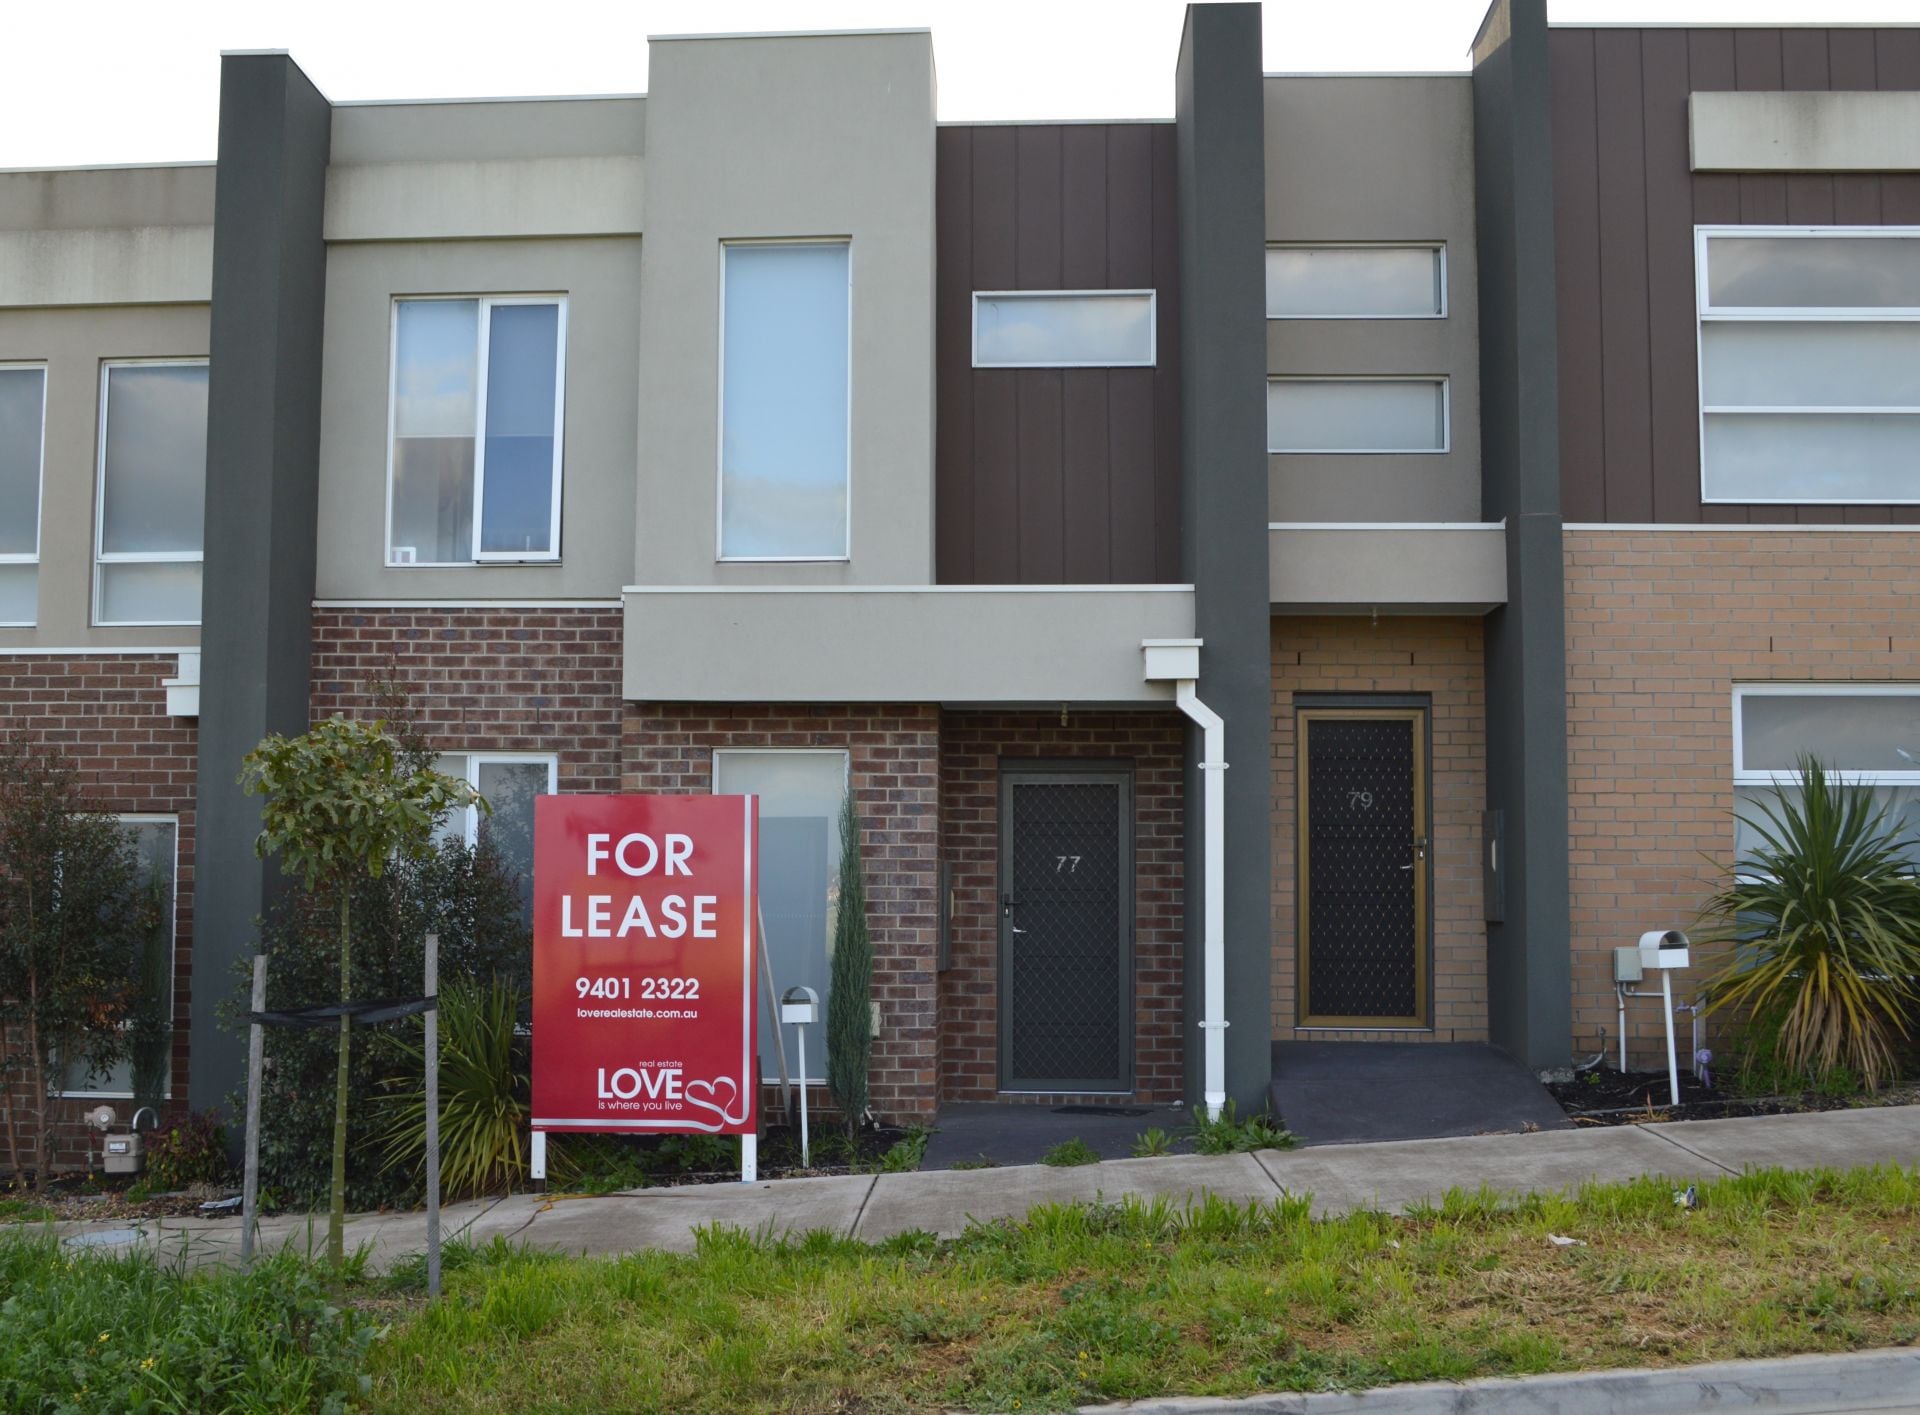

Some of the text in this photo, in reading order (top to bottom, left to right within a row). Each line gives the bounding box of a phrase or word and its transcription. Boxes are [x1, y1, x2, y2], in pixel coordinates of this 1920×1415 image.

[1348, 791, 1373, 808] 79
[587, 833, 694, 876] FOR
[1056, 855, 1081, 873] 77
[562, 895, 717, 938] LEASE
[575, 977, 700, 999] 9401 2322
[577, 1008, 698, 1019] loverealestate.com.au
[640, 1060, 683, 1068] real estate
[598, 1067, 683, 1099] LOVE
[598, 1100, 683, 1112] is where you live
